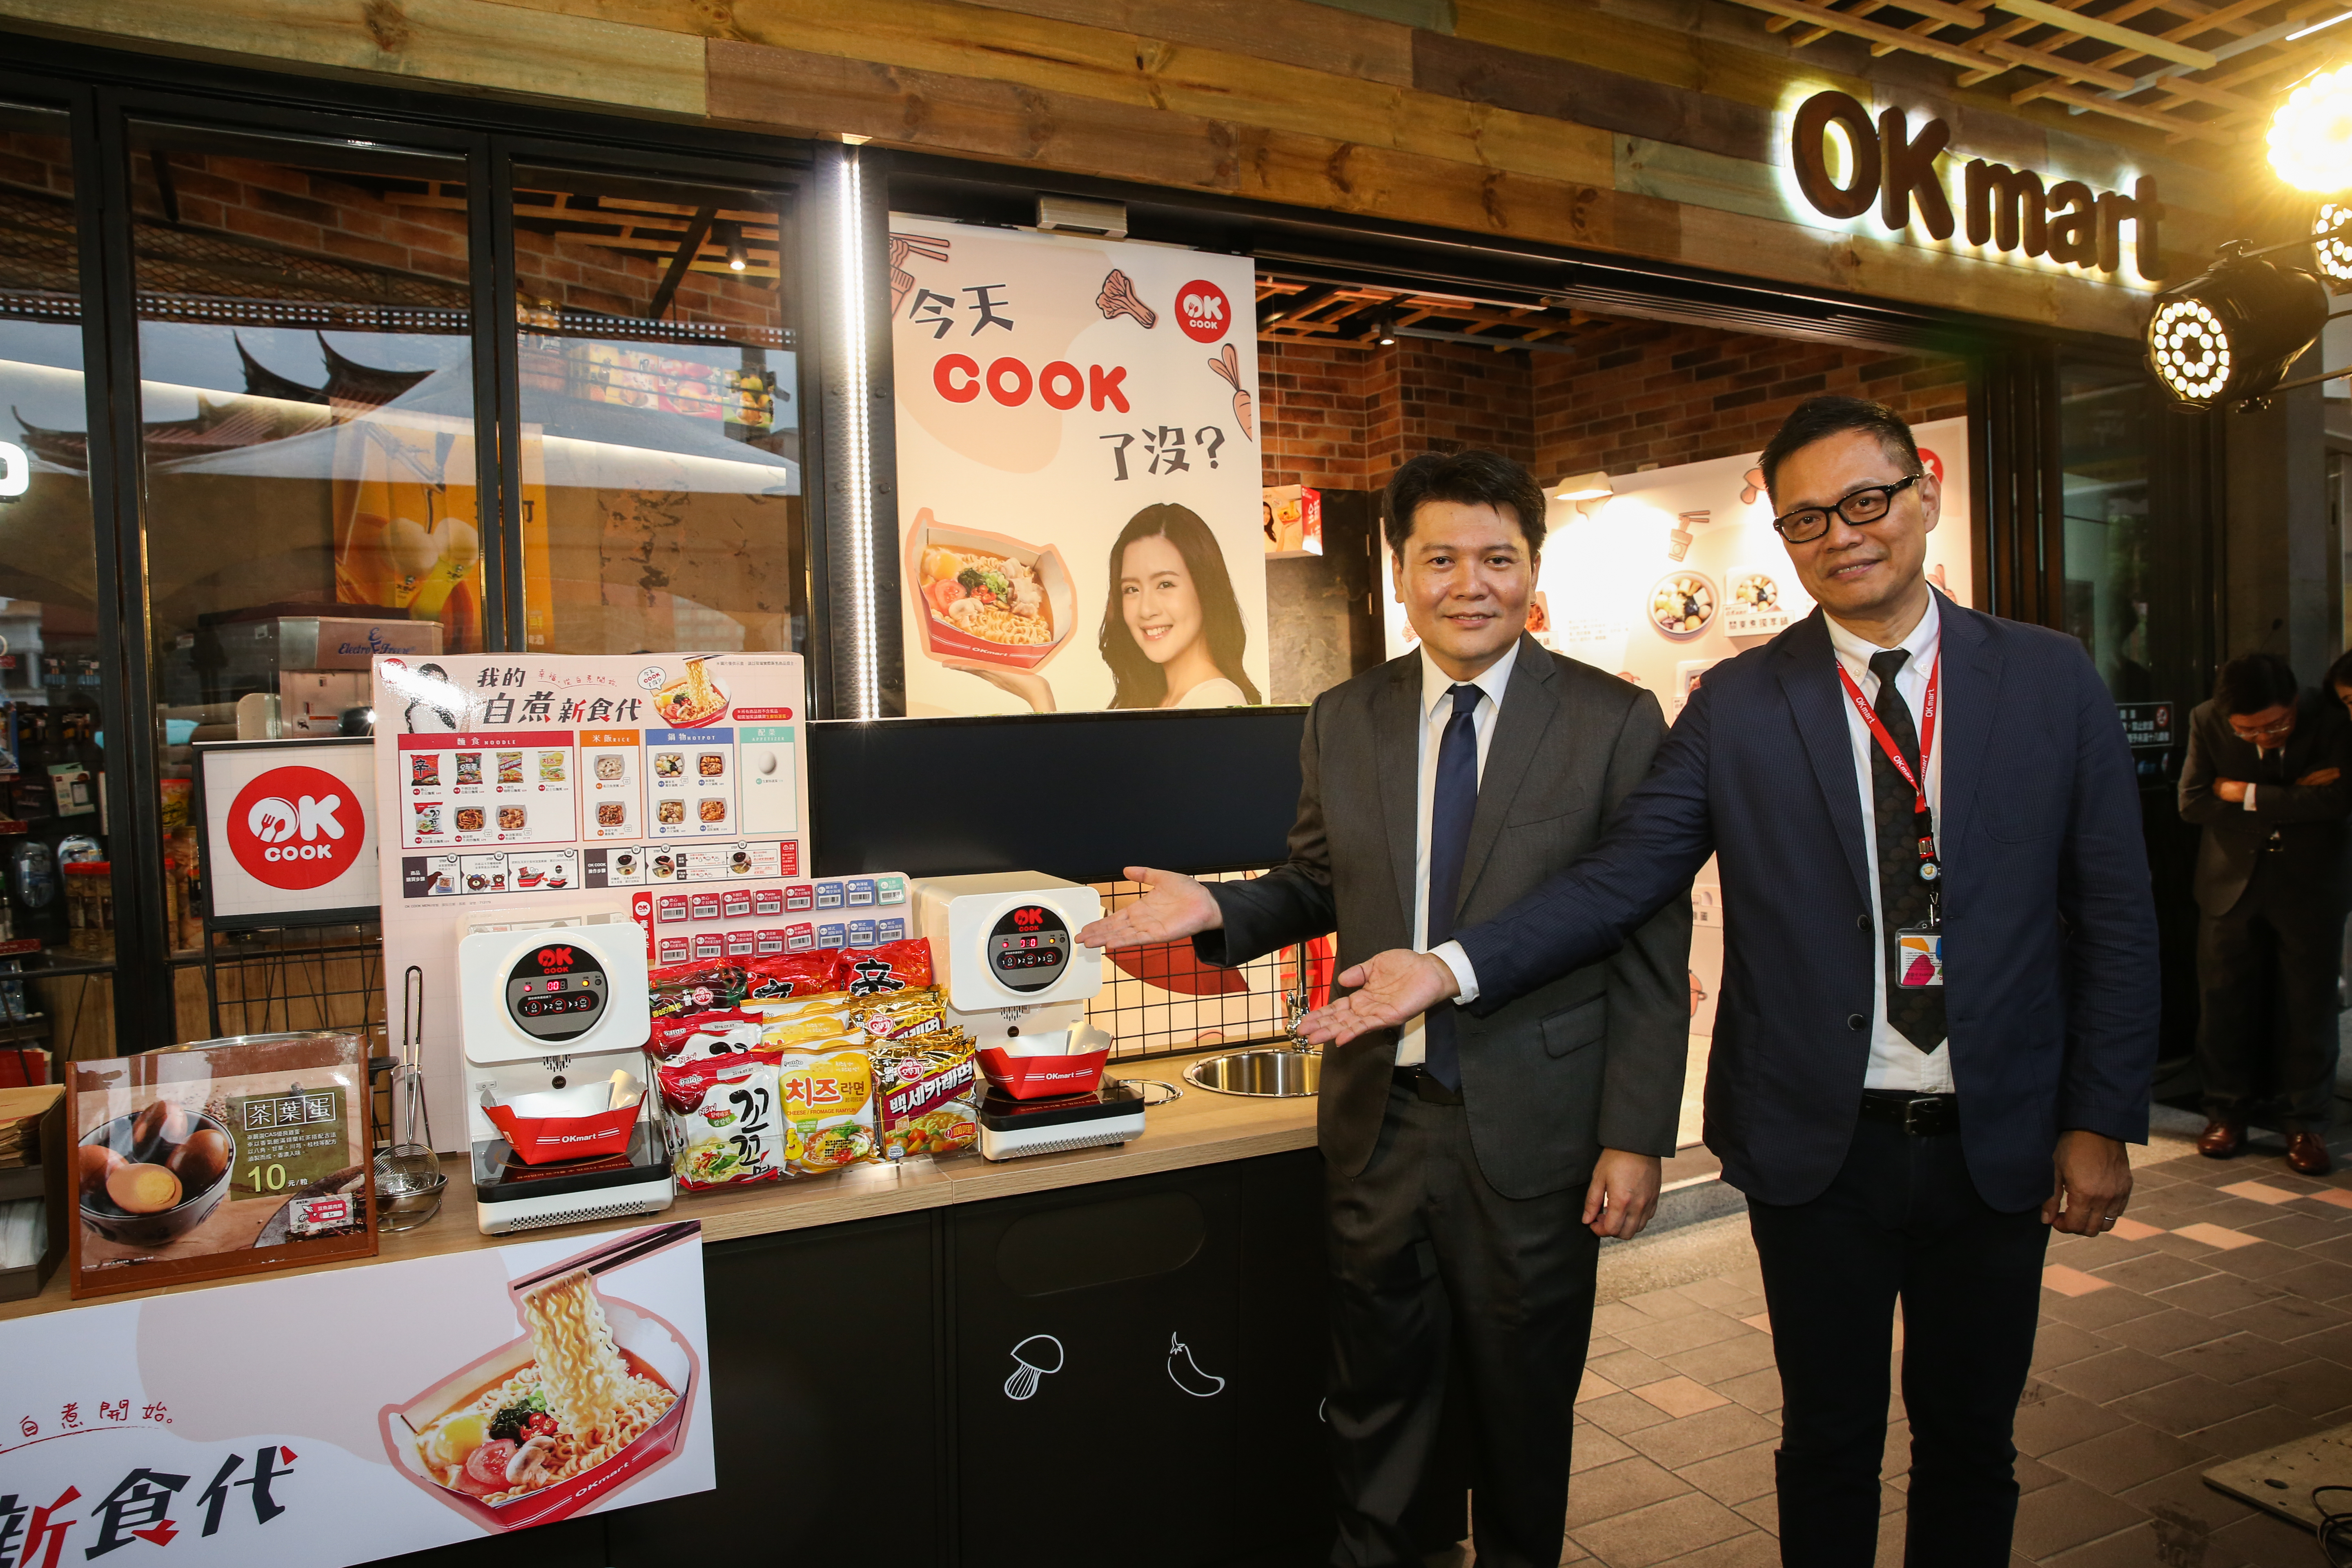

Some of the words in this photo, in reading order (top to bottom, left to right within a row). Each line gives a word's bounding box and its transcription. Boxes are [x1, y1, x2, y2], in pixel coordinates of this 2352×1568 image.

[909, 283, 1014, 339] 今天
[1183, 294, 1223, 320] OK
[1189, 319, 1218, 330] COOK
[933, 353, 1130, 414] COOK
[971, 646, 1009, 657] OKmart
[477, 667, 526, 688] 我的
[644, 672, 661, 683] COOK
[483, 691, 643, 724] 自煮新食代
[1855, 697, 1875, 724] OKmart
[1926, 688, 1934, 717] OKmart
[457, 737, 480, 746] 麵食
[592, 734, 612, 743] 米飯
[667, 733, 686, 742] 鍋物
[248, 794, 345, 843] OK
[264, 844, 332, 862] COOK
[1014, 908, 1043, 925] OK
[538, 947, 574, 967] OK
[872, 1022, 890, 1030] 오뚜기
[678, 1053, 697, 1064] NEW
[679, 1074, 703, 1087] paldo
[1046, 1072, 1074, 1080] OKmart
[786, 1077, 841, 1107] 치즈
[841, 1081, 864, 1095] 라면
[889, 1061, 973, 1114] 백세카레면
[249, 1097, 331, 1125] 茶葉蛋
[698, 1103, 717, 1117] NEW
[562, 1133, 597, 1143] OKmart
[953, 1125, 973, 1136] 咖哩
[248, 1164, 286, 1192] 10
[288, 1178, 308, 1187] 元/粒
[575, 1462, 629, 1497] OKmart
[0, 1446, 298, 1568] 新食代
